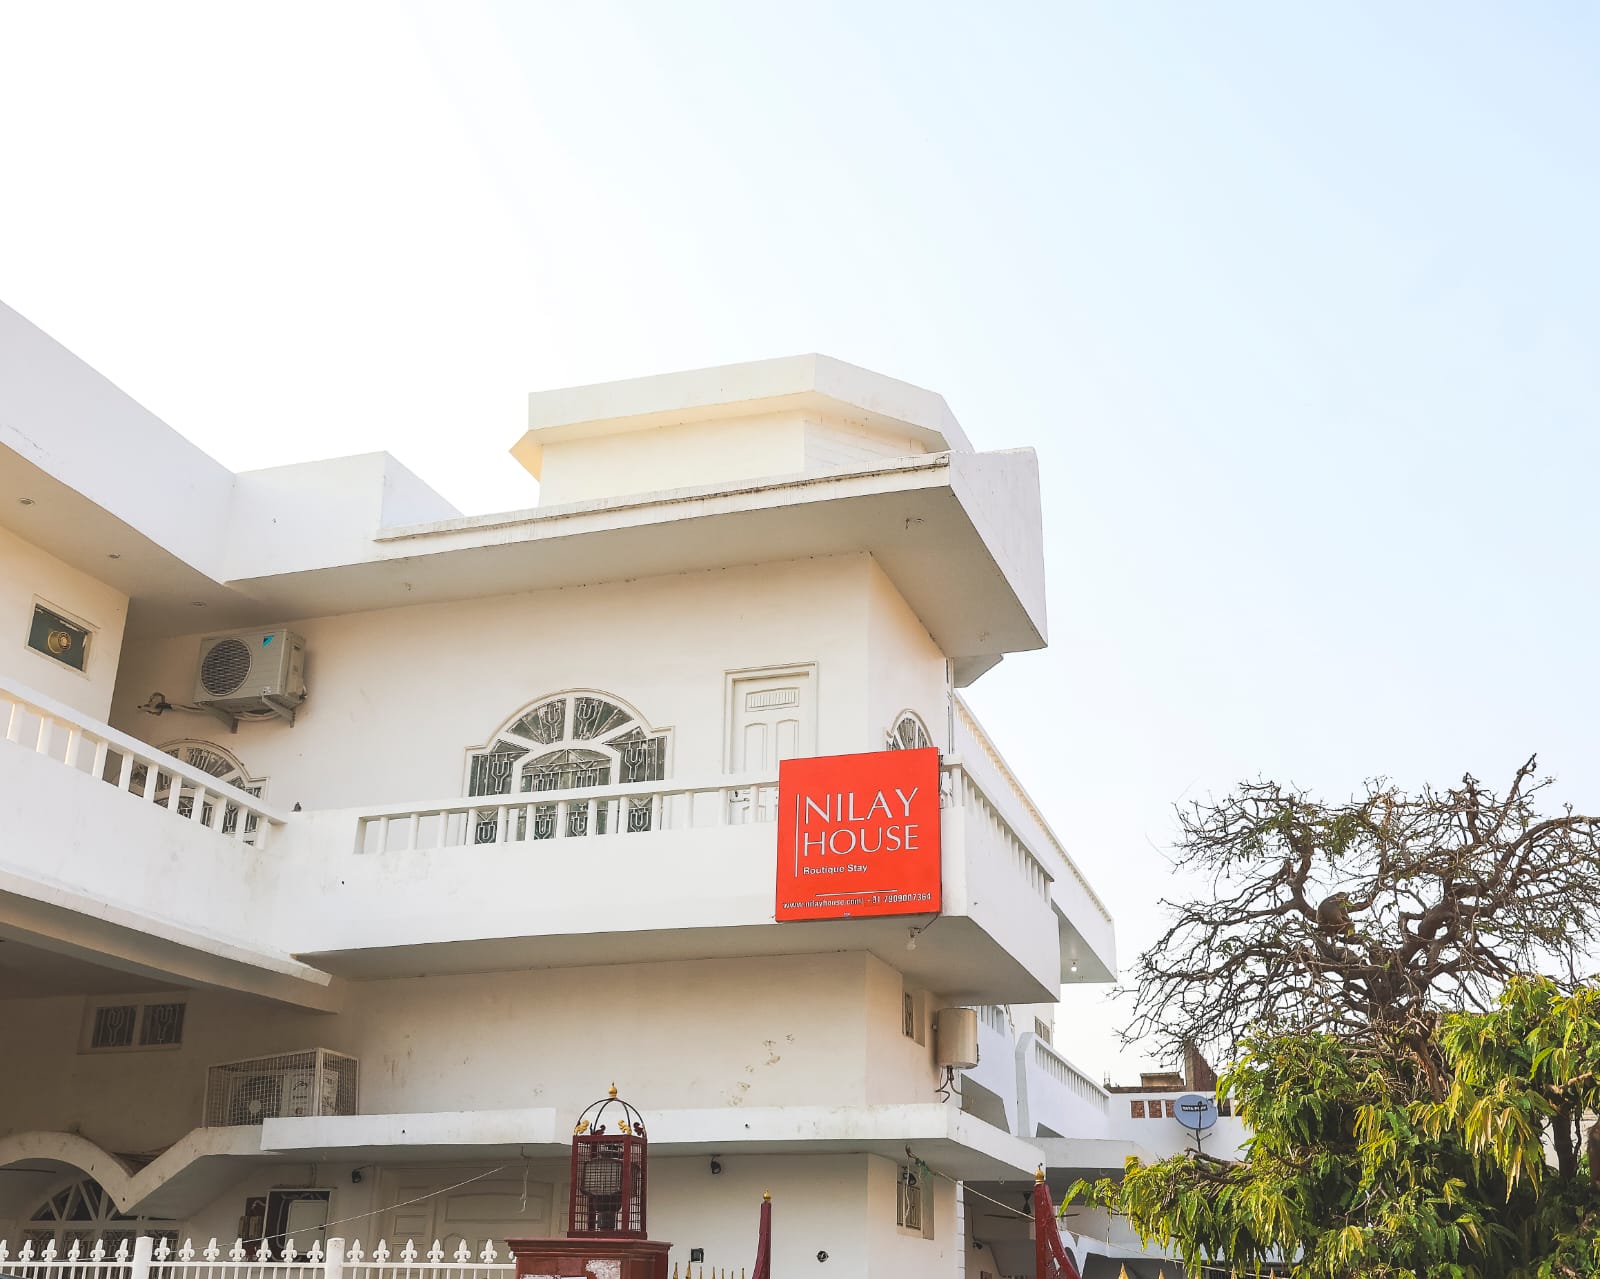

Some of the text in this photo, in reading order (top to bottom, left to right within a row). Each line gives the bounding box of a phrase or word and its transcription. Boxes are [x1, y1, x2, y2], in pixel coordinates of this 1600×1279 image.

[804, 787, 919, 825] NILAY
[803, 824, 919, 857] HOUSE
[803, 864, 868, 875] Boutique Stay
